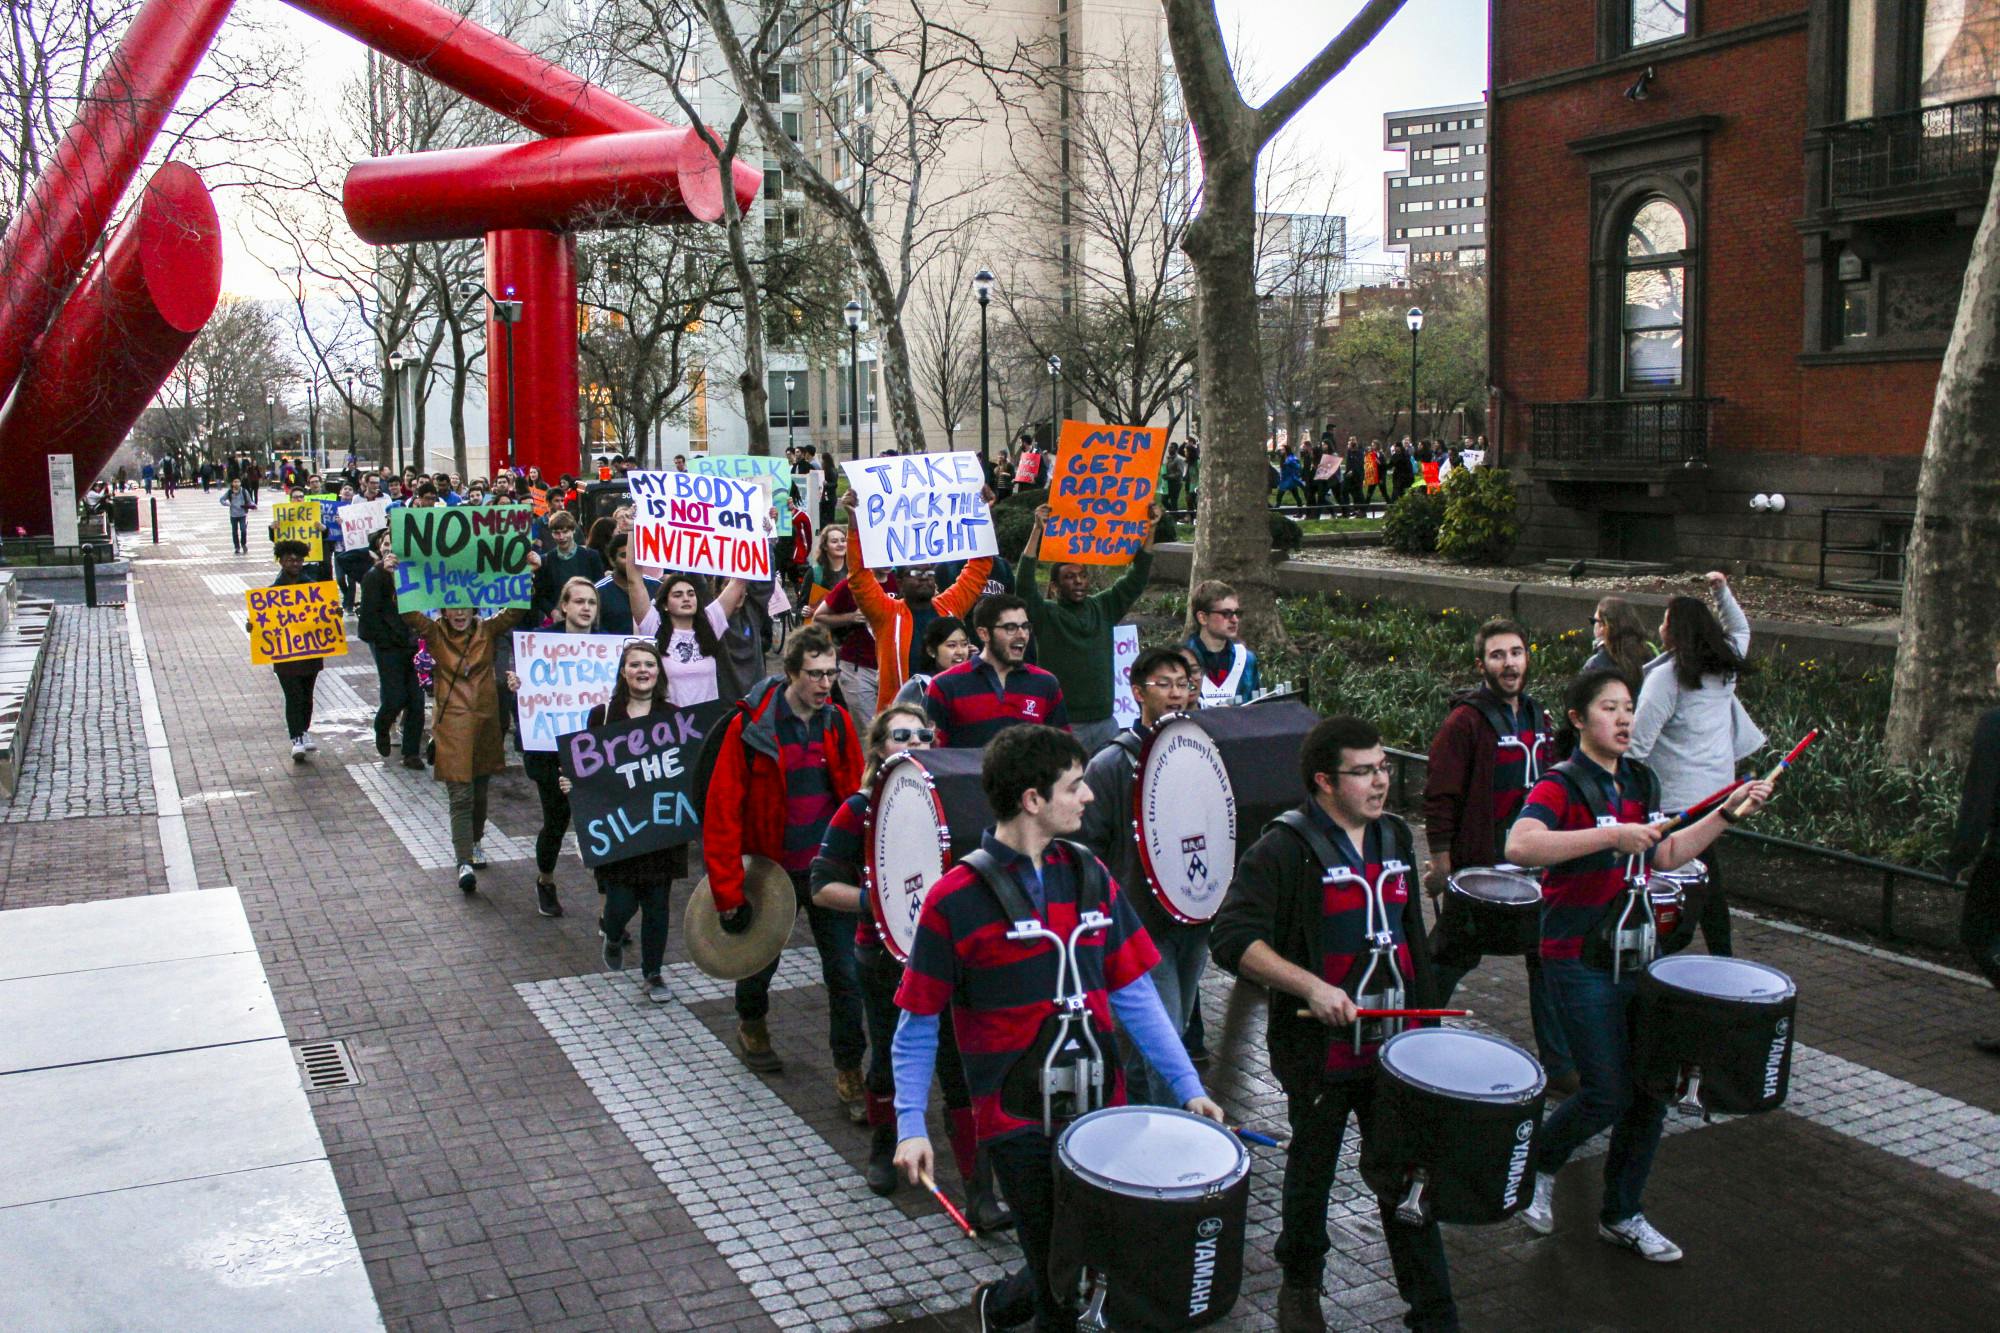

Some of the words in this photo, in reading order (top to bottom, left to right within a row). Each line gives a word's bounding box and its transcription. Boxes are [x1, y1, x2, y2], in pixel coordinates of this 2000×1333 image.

[1082, 430, 1152, 454] MEN
[699, 459, 787, 488] BREAK
[865, 456, 978, 494] TAKE
[1068, 454, 1132, 475] GET
[631, 473, 668, 496] MY
[674, 473, 758, 512] BODY
[1060, 476, 1151, 501] RAPED
[277, 506, 313, 522] HERE
[345, 516, 373, 532] NOT
[645, 494, 667, 519] is
[671, 499, 714, 526] NOT
[718, 510, 754, 532] an
[867, 492, 944, 528] BACK
[947, 492, 987, 518] THE
[1077, 498, 1127, 516] TOO
[404, 510, 471, 557] NO
[886, 518, 989, 562] NIGHT
[1045, 516, 1097, 537] END
[1106, 519, 1149, 536] THE
[477, 534, 532, 574] NO
[635, 523, 769, 576] INVITATION
[395, 560, 420, 595] I
[424, 560, 484, 594] Have
[444, 590, 459, 605] a
[467, 573, 532, 607] VOICE
[250, 586, 324, 611] BREAK
[261, 618, 343, 655] Silence!
[277, 610, 306, 627] the
[529, 658, 617, 686] OUTRAG
[519, 691, 573, 717] you're
[569, 712, 704, 778] Break
[1168, 736, 1177, 753] of
[615, 747, 685, 789] THE
[1177, 735, 1228, 792] Pennsylvania
[1149, 751, 1168, 823] University
[587, 791, 698, 856] SILEN
[1225, 796, 1236, 840] Band
[1152, 828, 1162, 856] The
[1763, 1036, 1787, 1098] YAMAHA
[1503, 1139, 1530, 1210] YAMAHA
[1188, 1237, 1218, 1317] YAMAHA
